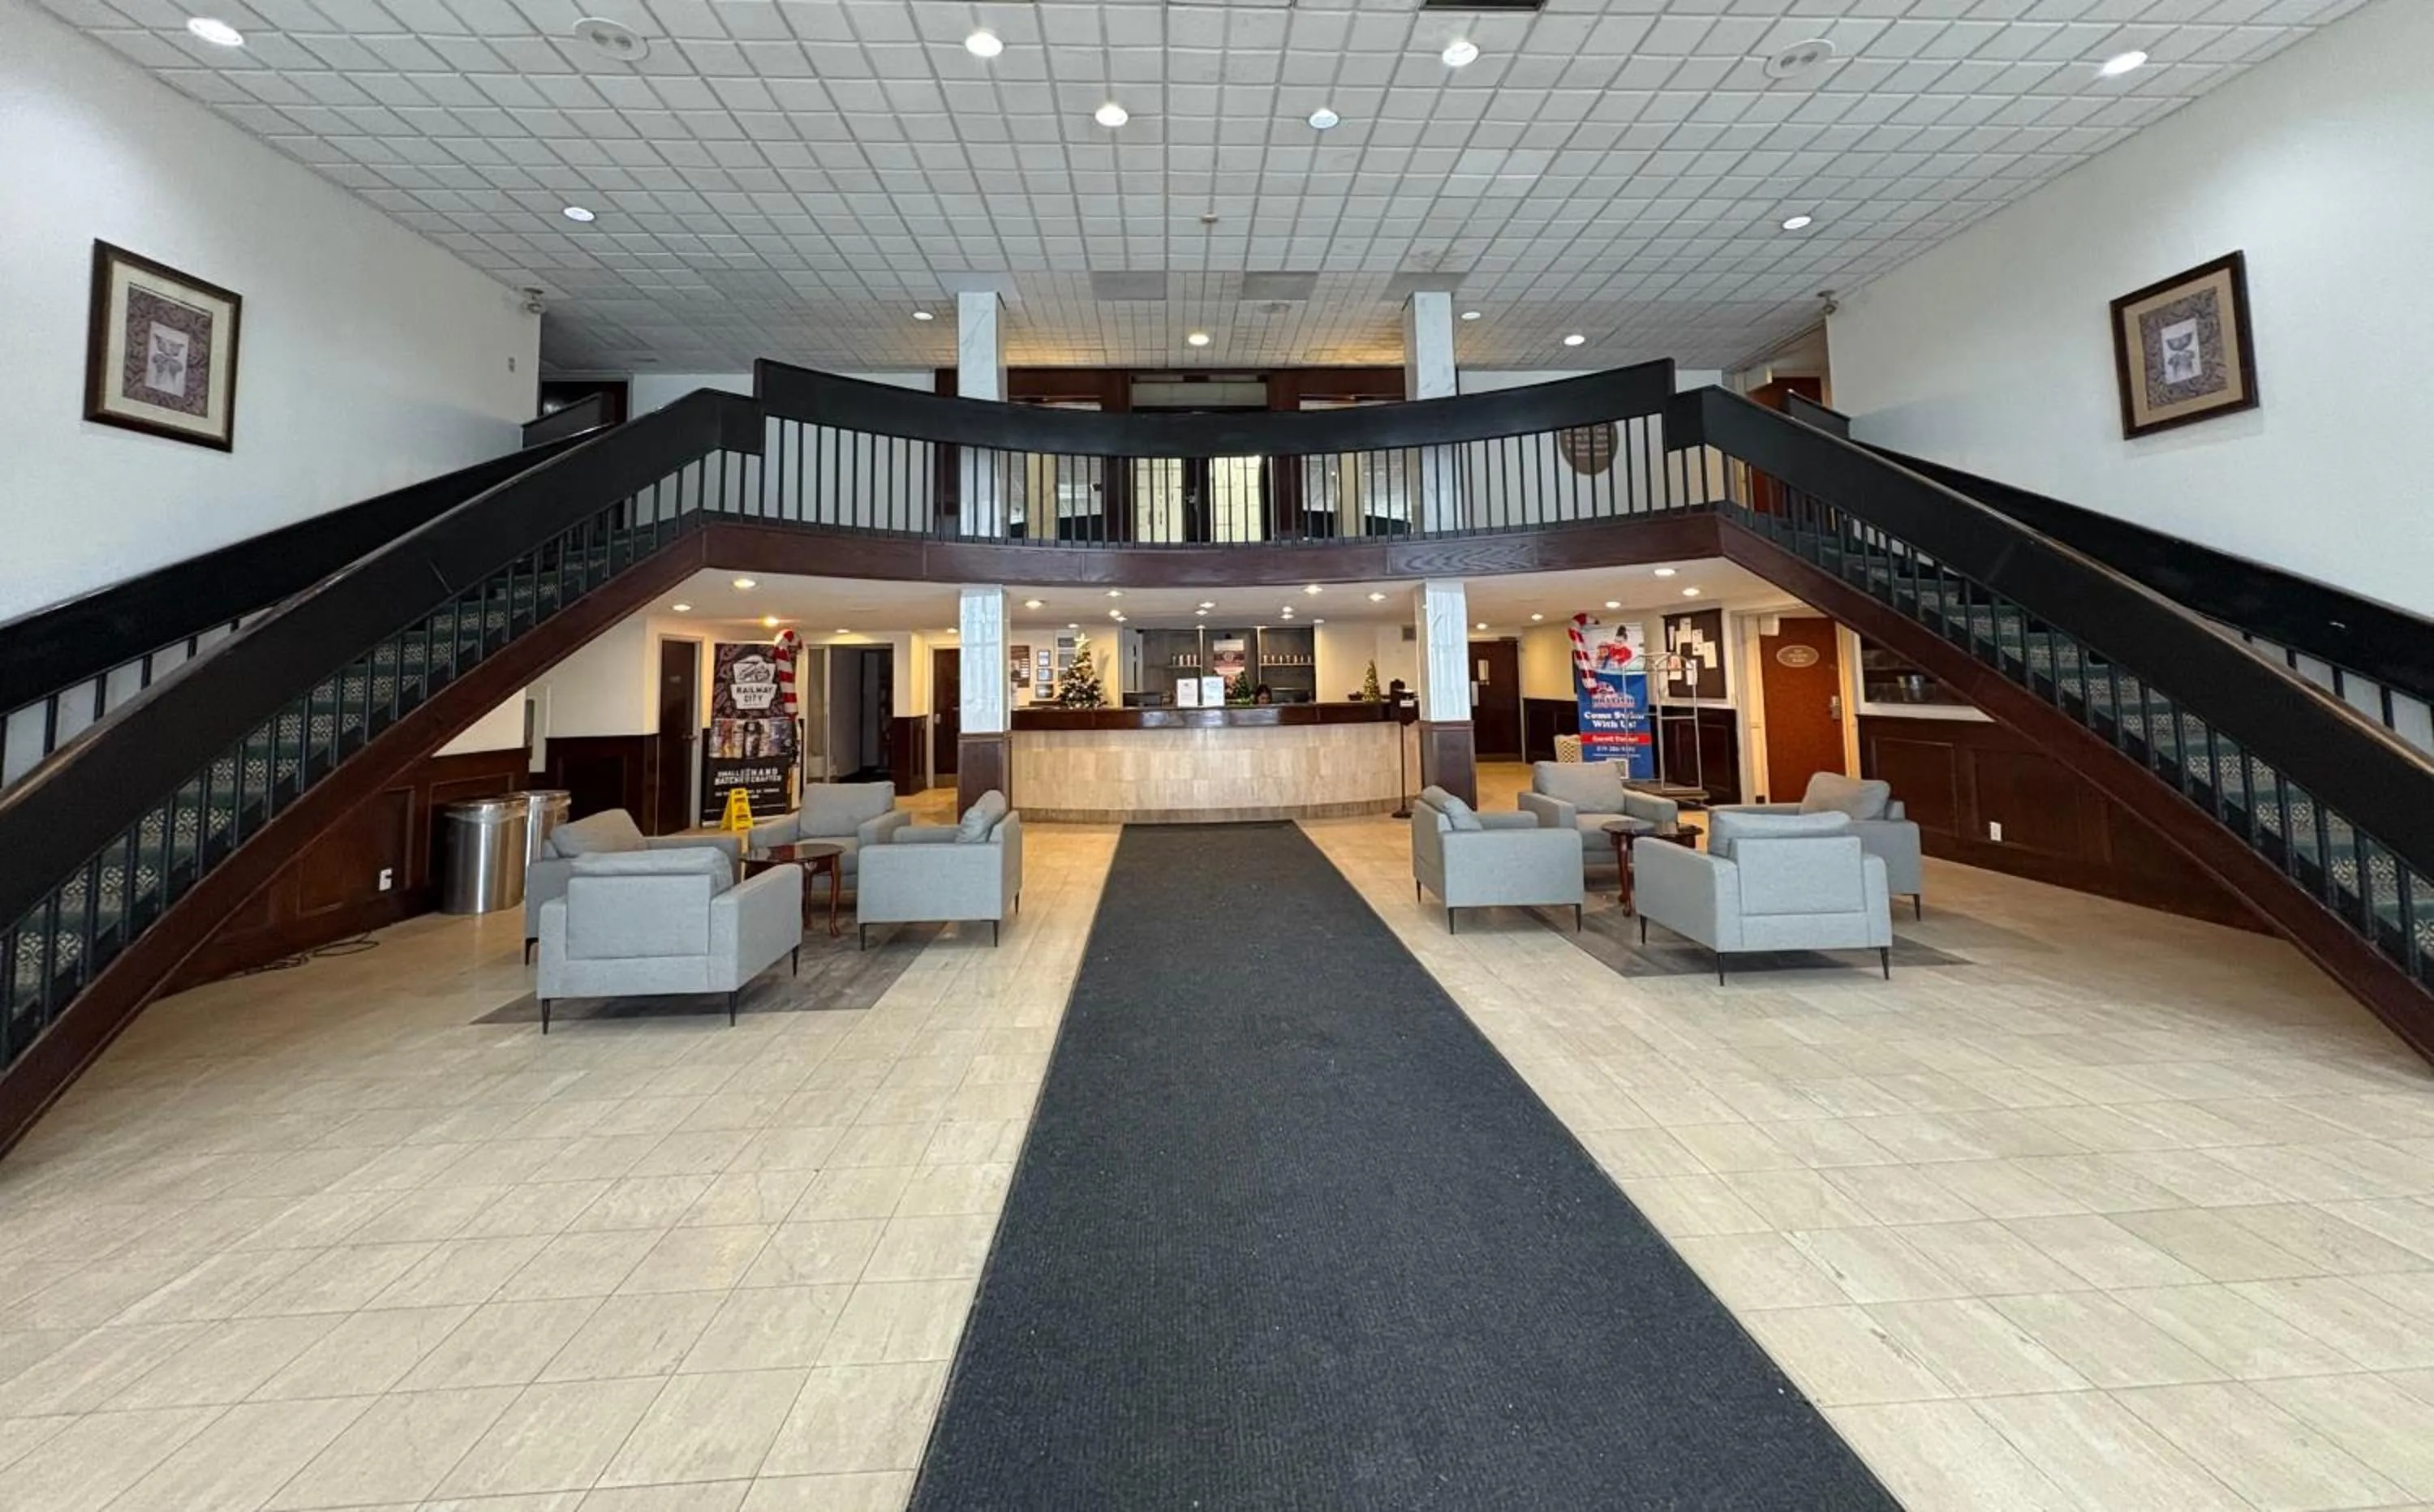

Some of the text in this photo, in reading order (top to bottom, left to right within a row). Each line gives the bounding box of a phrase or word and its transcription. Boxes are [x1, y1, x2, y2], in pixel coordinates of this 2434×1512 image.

[744, 694, 763, 702] CITY
[1592, 719, 1618, 728] With
[751, 767, 778, 775] HAND
